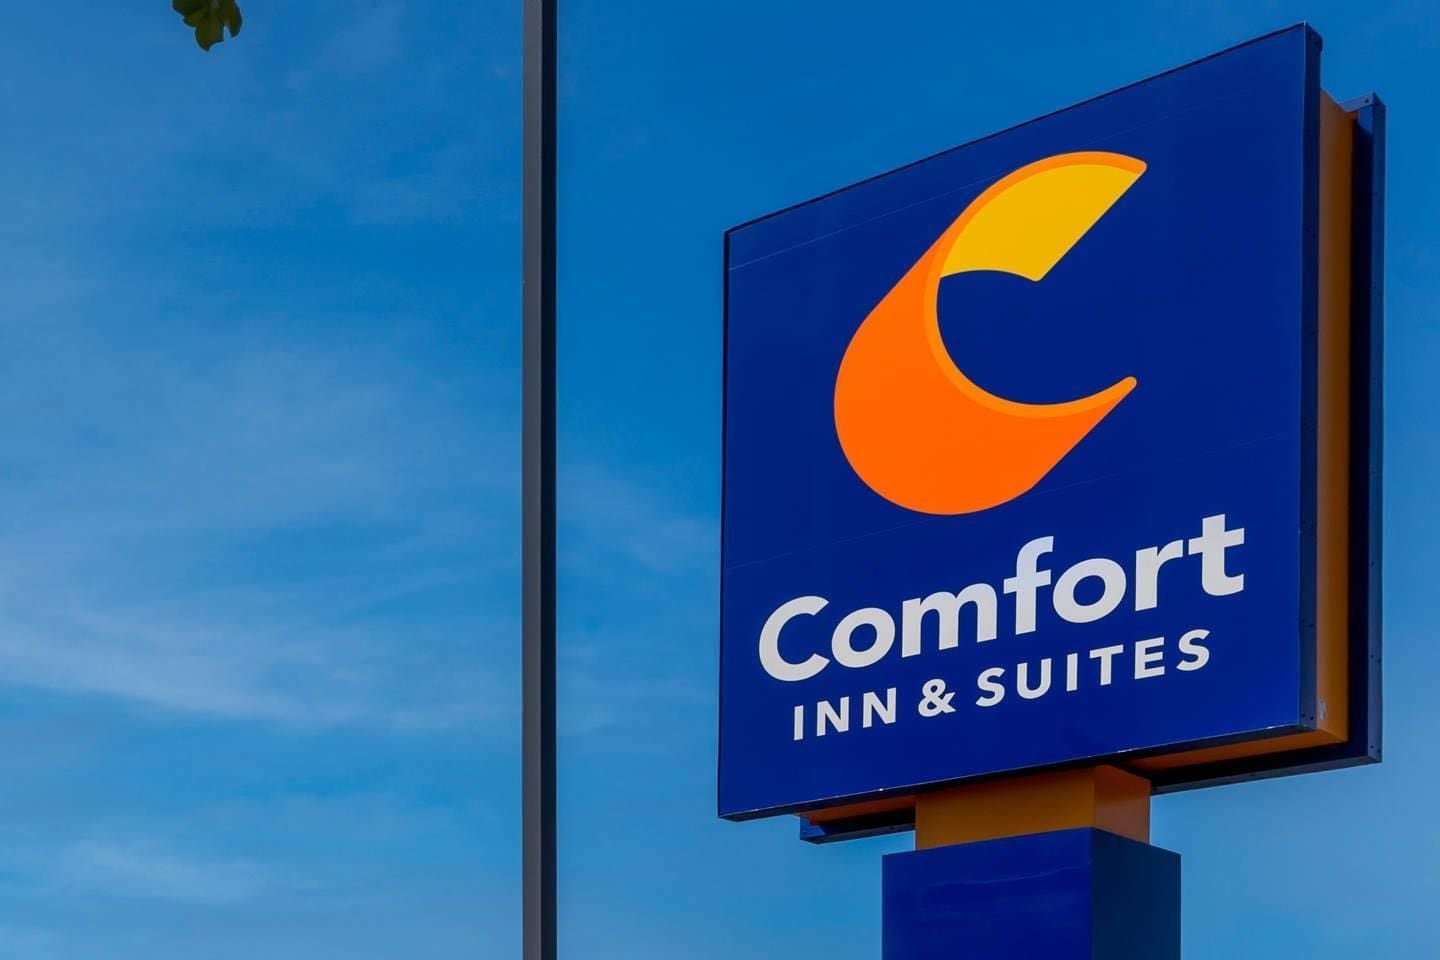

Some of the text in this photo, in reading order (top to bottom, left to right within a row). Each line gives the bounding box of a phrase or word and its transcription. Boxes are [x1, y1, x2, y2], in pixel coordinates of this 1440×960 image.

[759, 513, 1245, 682] Comfort
[793, 628, 1211, 741] INN & SUITES
